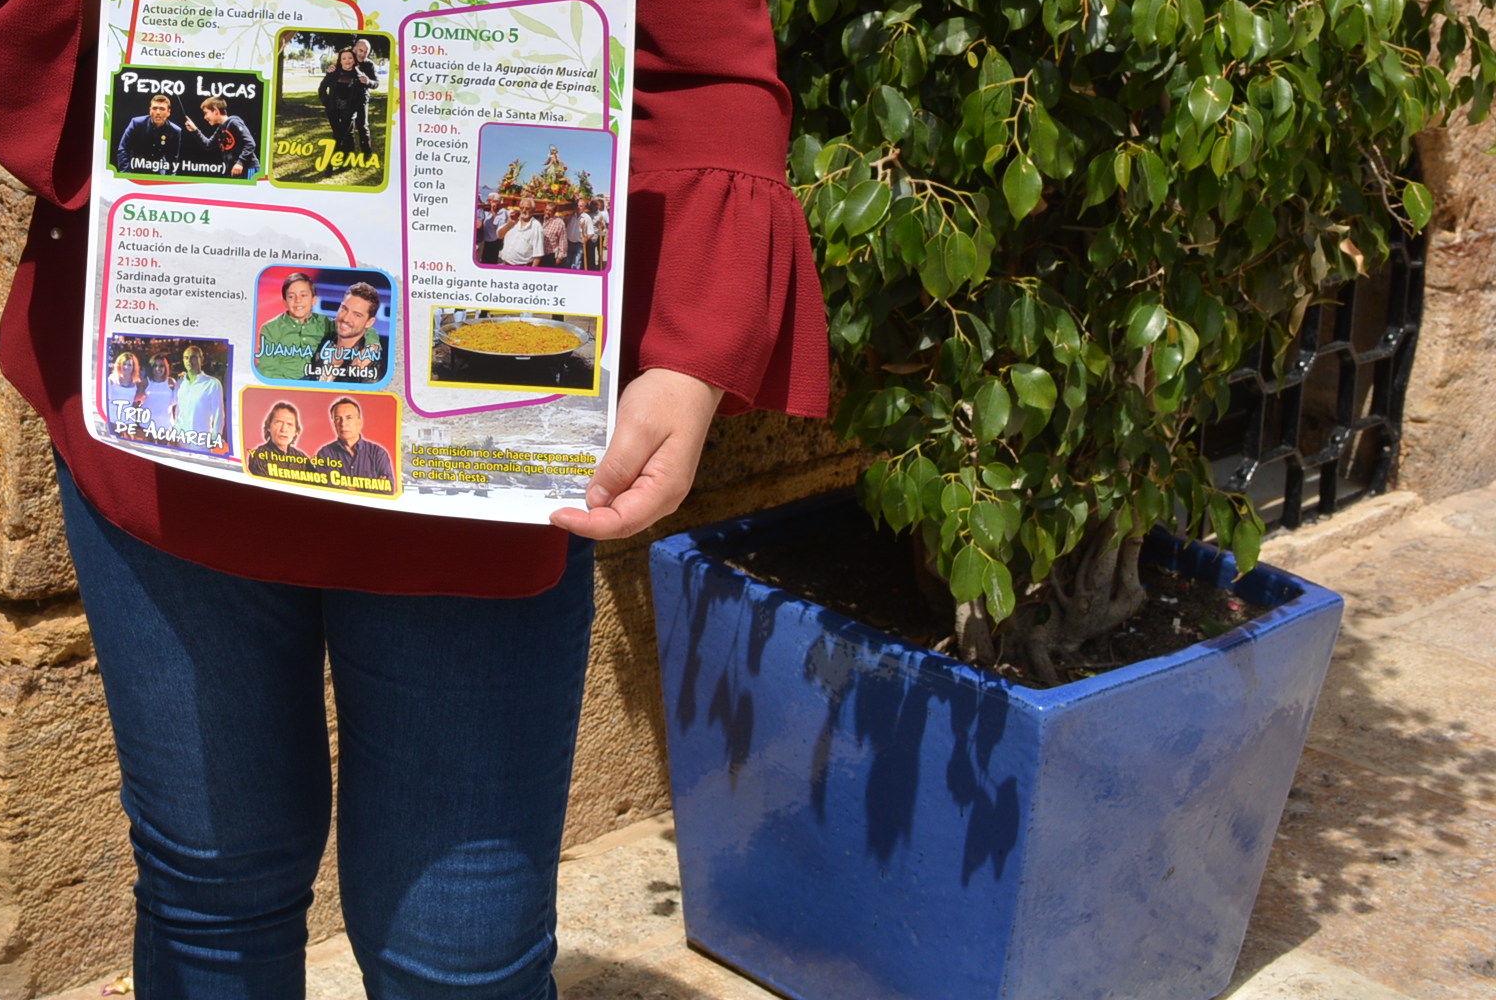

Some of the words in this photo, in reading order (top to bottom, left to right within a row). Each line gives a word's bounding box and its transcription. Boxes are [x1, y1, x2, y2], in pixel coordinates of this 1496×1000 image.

[141, 32, 171, 43] 22:30
[175, 33, 184, 43] h.
[508, 28, 518, 43] 5
[141, 46, 206, 58] Actuaciones
[209, 49, 224, 59] de:
[410, 60, 463, 70] Actuación
[467, 62, 481, 71] de
[484, 63, 492, 72] la
[495, 63, 553, 76] Agupación
[556, 67, 597, 78] Musical
[412, 91, 442, 100] 10:30
[445, 92, 455, 101] h.
[411, 105, 474, 116] Celebración
[478, 108, 490, 117] de
[494, 109, 503, 118] la
[506, 110, 536, 120] Santa
[539, 112, 567, 122] Misa.
[131, 157, 169, 170] (Magia
[173, 162, 180, 171] y
[182, 160, 226, 173] Humor)
[200, 210, 209, 224] 4
[119, 228, 149, 237] 21:00
[153, 228, 162, 238] h.
[412, 275, 443, 286] Paella
[447, 278, 487, 290] gigante
[490, 279, 519, 290] hasta
[522, 283, 558, 293] agotar
[411, 291, 472, 301] existencias.
[475, 293, 550, 306] Colaboración:
[553, 297, 566, 306] 3€
[304, 364, 323, 376] (La
[325, 366, 345, 376] Voz
[349, 366, 377, 379] Kids)
[268, 463, 328, 485] HERMANOS
[331, 470, 392, 491] CALATRAVA
